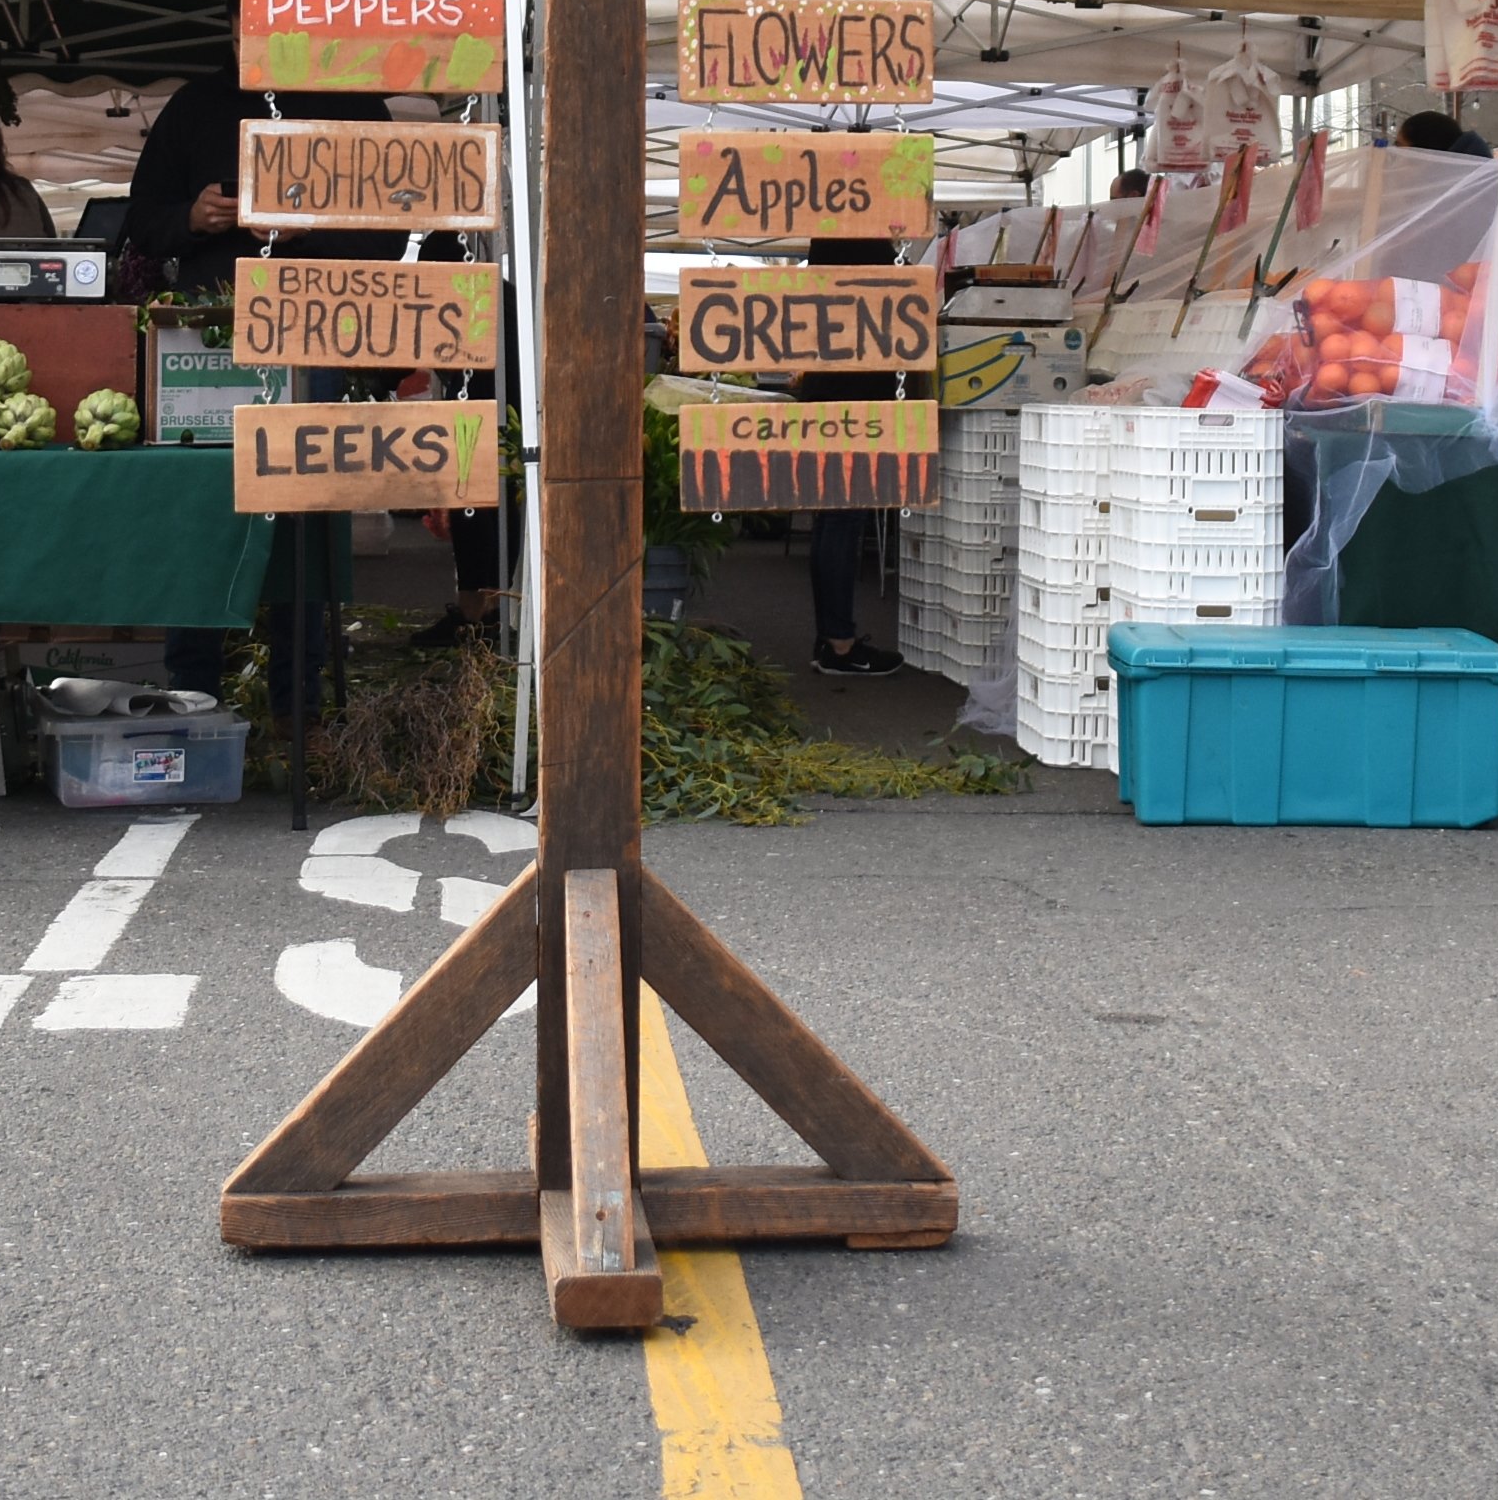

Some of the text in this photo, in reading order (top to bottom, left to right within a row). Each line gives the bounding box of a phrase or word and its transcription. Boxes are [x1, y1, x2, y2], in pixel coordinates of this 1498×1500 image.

[697, 8, 926, 90] FLOWERS
[253, 133, 486, 213] MUSHROOMS
[702, 147, 871, 232] Apples
[279, 266, 433, 298] BRUSSEL
[741, 271, 832, 293] LEAFY
[247, 296, 464, 361] SPROUTS
[689, 294, 930, 364] GREENS
[166, 354, 233, 371] COVER
[160, 415, 225, 426] BRUSSELS
[732, 410, 884, 440] carrots
[255, 423, 450, 477] LEEKS
[47, 647, 115, 671] California
